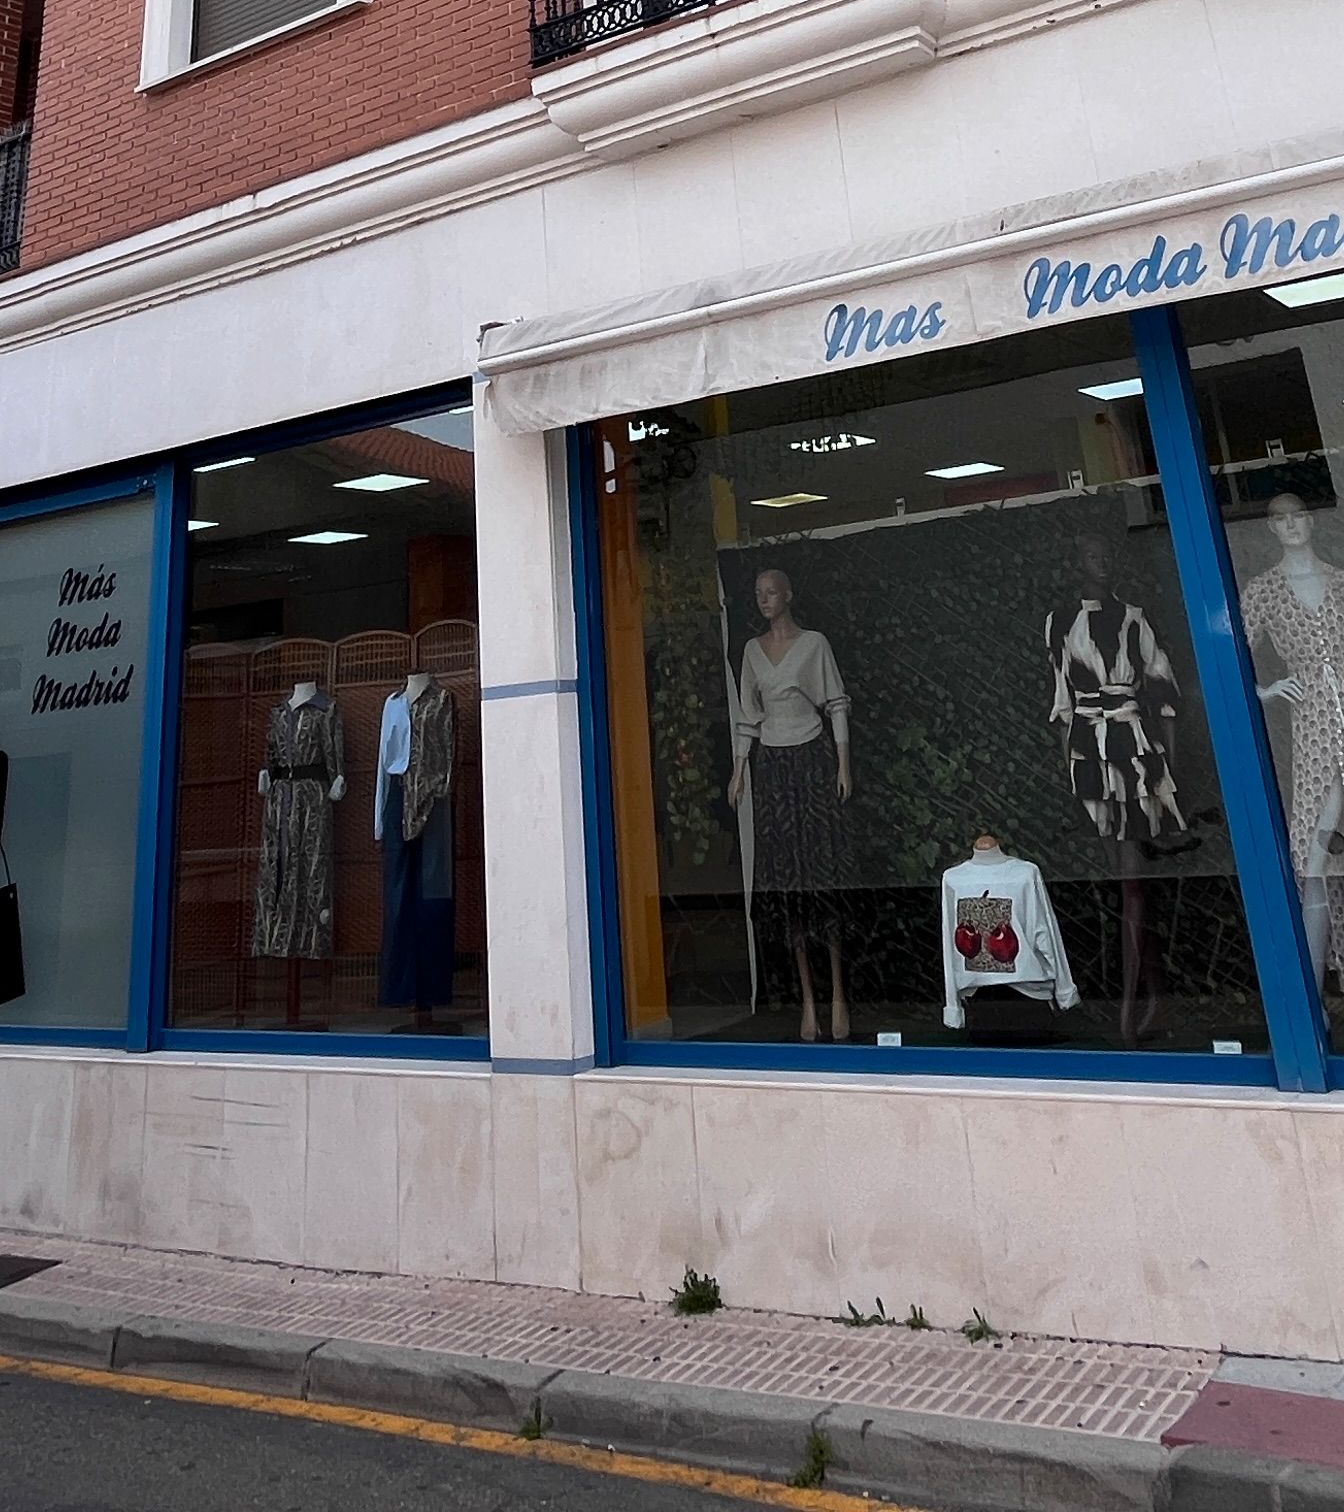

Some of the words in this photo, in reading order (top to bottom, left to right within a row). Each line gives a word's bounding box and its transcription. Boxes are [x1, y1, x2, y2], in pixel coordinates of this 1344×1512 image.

[825, 301, 946, 361] Mas
[1024, 235, 1207, 319] Moda
[58, 563, 117, 607] Más
[46, 611, 122, 657] Moda
[31, 664, 134, 715] Madrid
